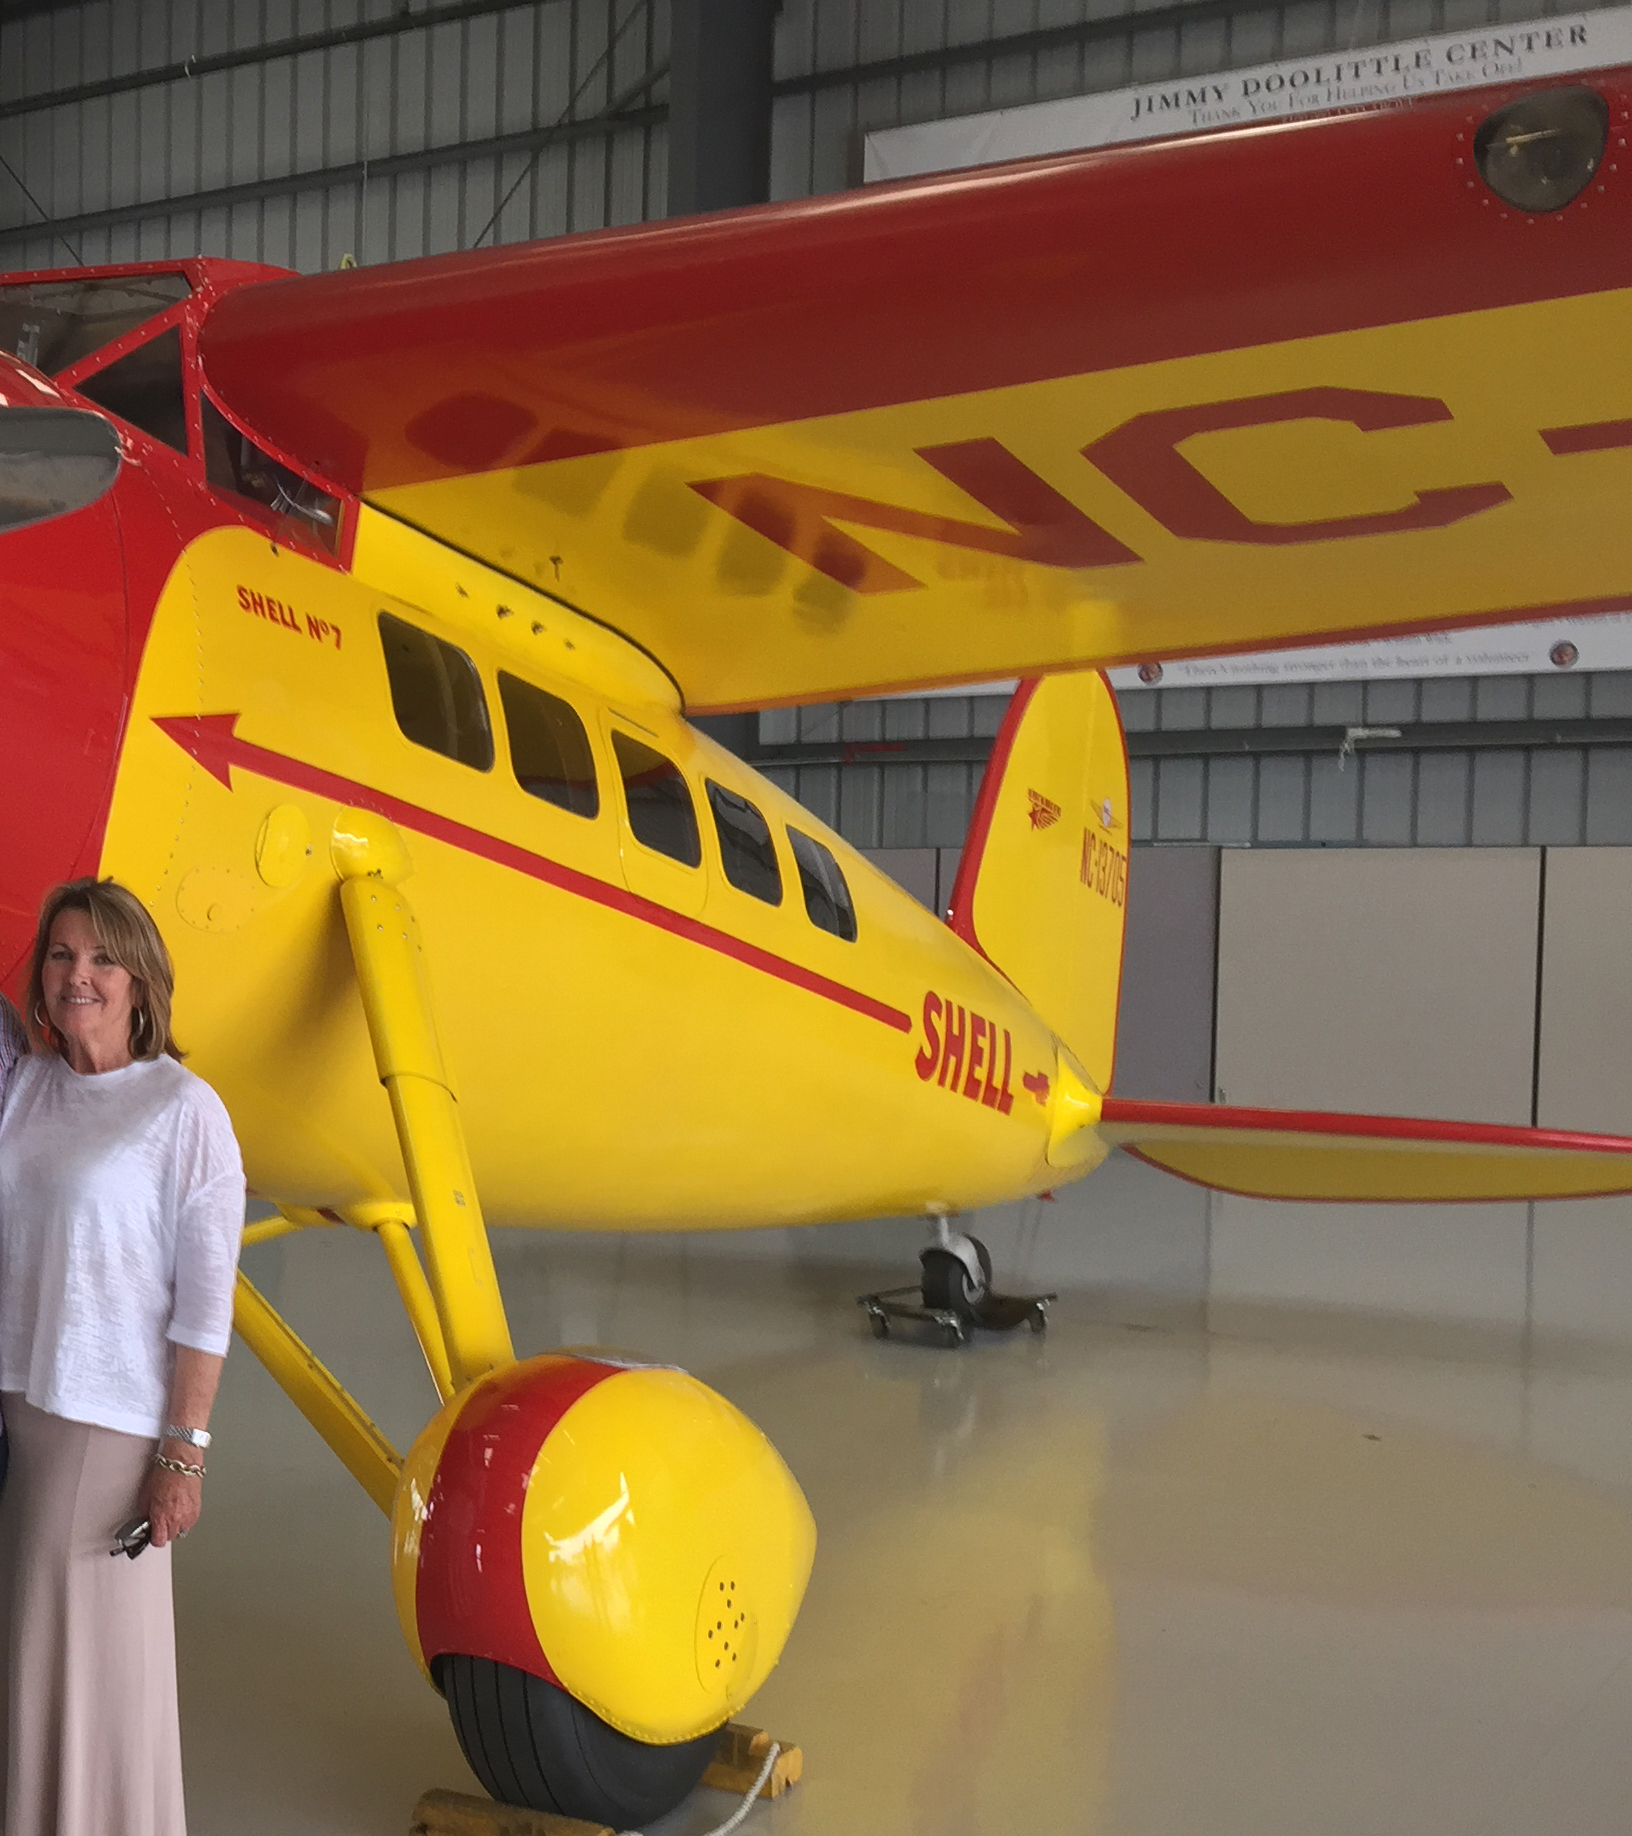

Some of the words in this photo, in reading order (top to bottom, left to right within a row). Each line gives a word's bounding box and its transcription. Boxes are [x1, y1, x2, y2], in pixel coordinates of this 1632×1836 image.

[1130, 83, 1229, 121] JIMMY
[1241, 48, 1432, 97] DOOLITTLE
[1446, 24, 1587, 65] CENTER
[236, 584, 303, 634] SHELL
[915, 990, 1014, 1116] SHELL
